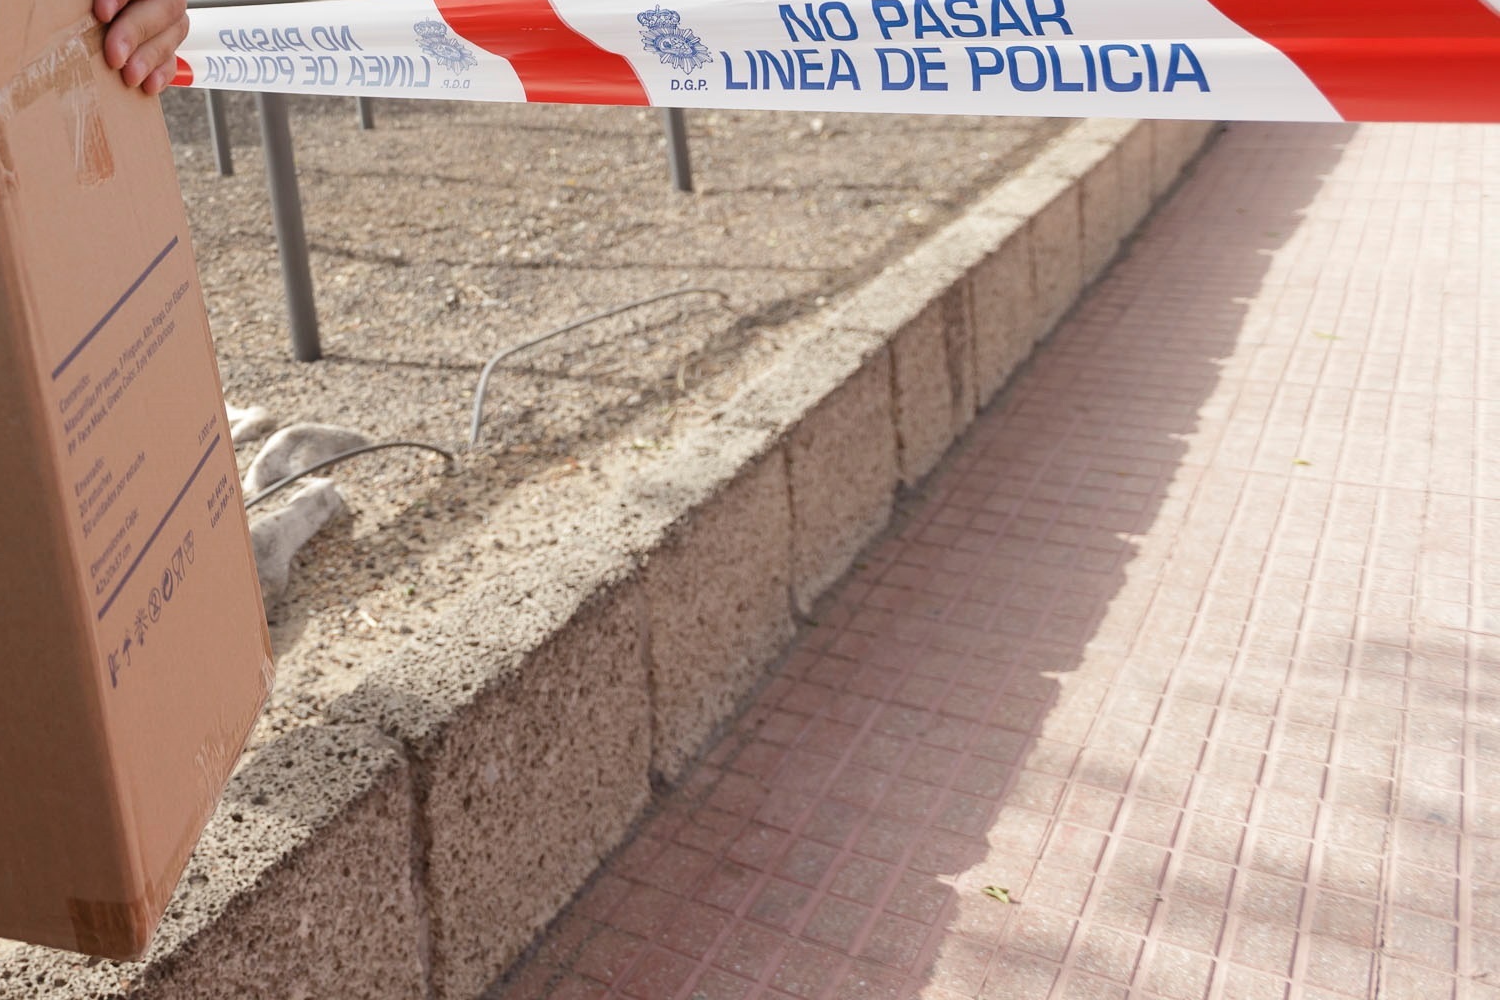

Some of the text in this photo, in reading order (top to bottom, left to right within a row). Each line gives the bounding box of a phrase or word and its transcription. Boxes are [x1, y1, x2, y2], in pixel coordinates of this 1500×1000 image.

[779, 1, 859, 42] NO
[670, 78, 709, 92] D.G.P.
[719, 43, 1211, 93] LINEA DE POLICIA
